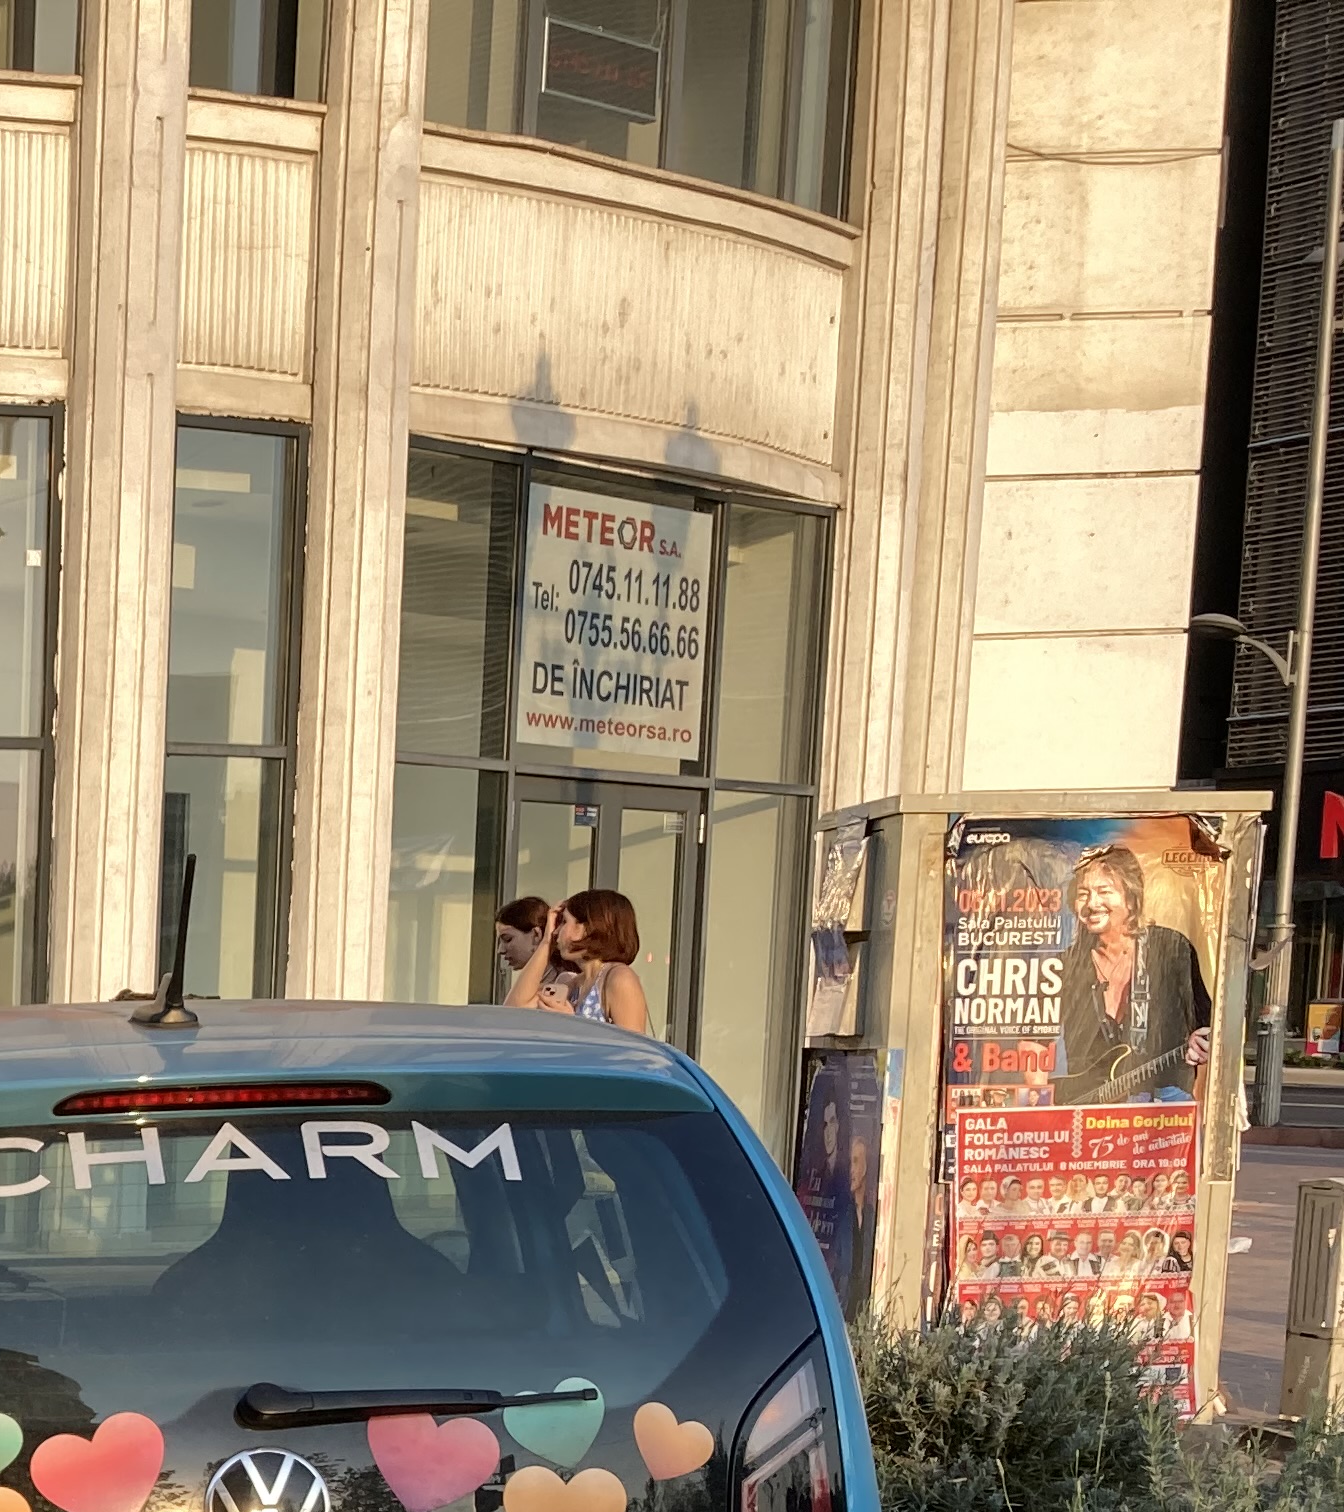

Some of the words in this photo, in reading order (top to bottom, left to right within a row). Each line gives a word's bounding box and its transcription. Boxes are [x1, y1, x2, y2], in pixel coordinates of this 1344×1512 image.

[542, 504, 656, 553] METEOR
[659, 539, 682, 558] S.A.
[532, 581, 560, 612] Tel:
[569, 559, 700, 613] 0745.11.11.88
[565, 608, 699, 660] 0755.56.66.66
[532, 661, 564, 696] DE
[572, 658, 689, 711] ÎNCHIRIAT
[526, 711, 692, 743] www.meteorsa.ro
[966, 832, 1011, 845] europa
[958, 916, 990, 930] Sala
[994, 915, 1062, 930] Palatului
[957, 931, 1062, 946] BUCURESTI
[956, 957, 1064, 996] CHRIS
[954, 996, 1061, 1024] NORMAN
[952, 1042, 972, 1072] &
[982, 1041, 1056, 1072] Band
[965, 1117, 1008, 1130] GALA
[1085, 1116, 1130, 1129] Doina
[1132, 1113, 1193, 1130] Gorjului
[964, 1130, 1070, 1146] FOLCLORULUI
[1088, 1135, 1114, 1158] 75
[964, 1145, 1050, 1161] ROMÂNESC
[963, 1163, 992, 1174] SALA
[994, 1162, 1054, 1173] PALATULUI
[1068, 1160, 1127, 1170] NOIEMBRIE
[1132, 1159, 1157, 1168] ORA
